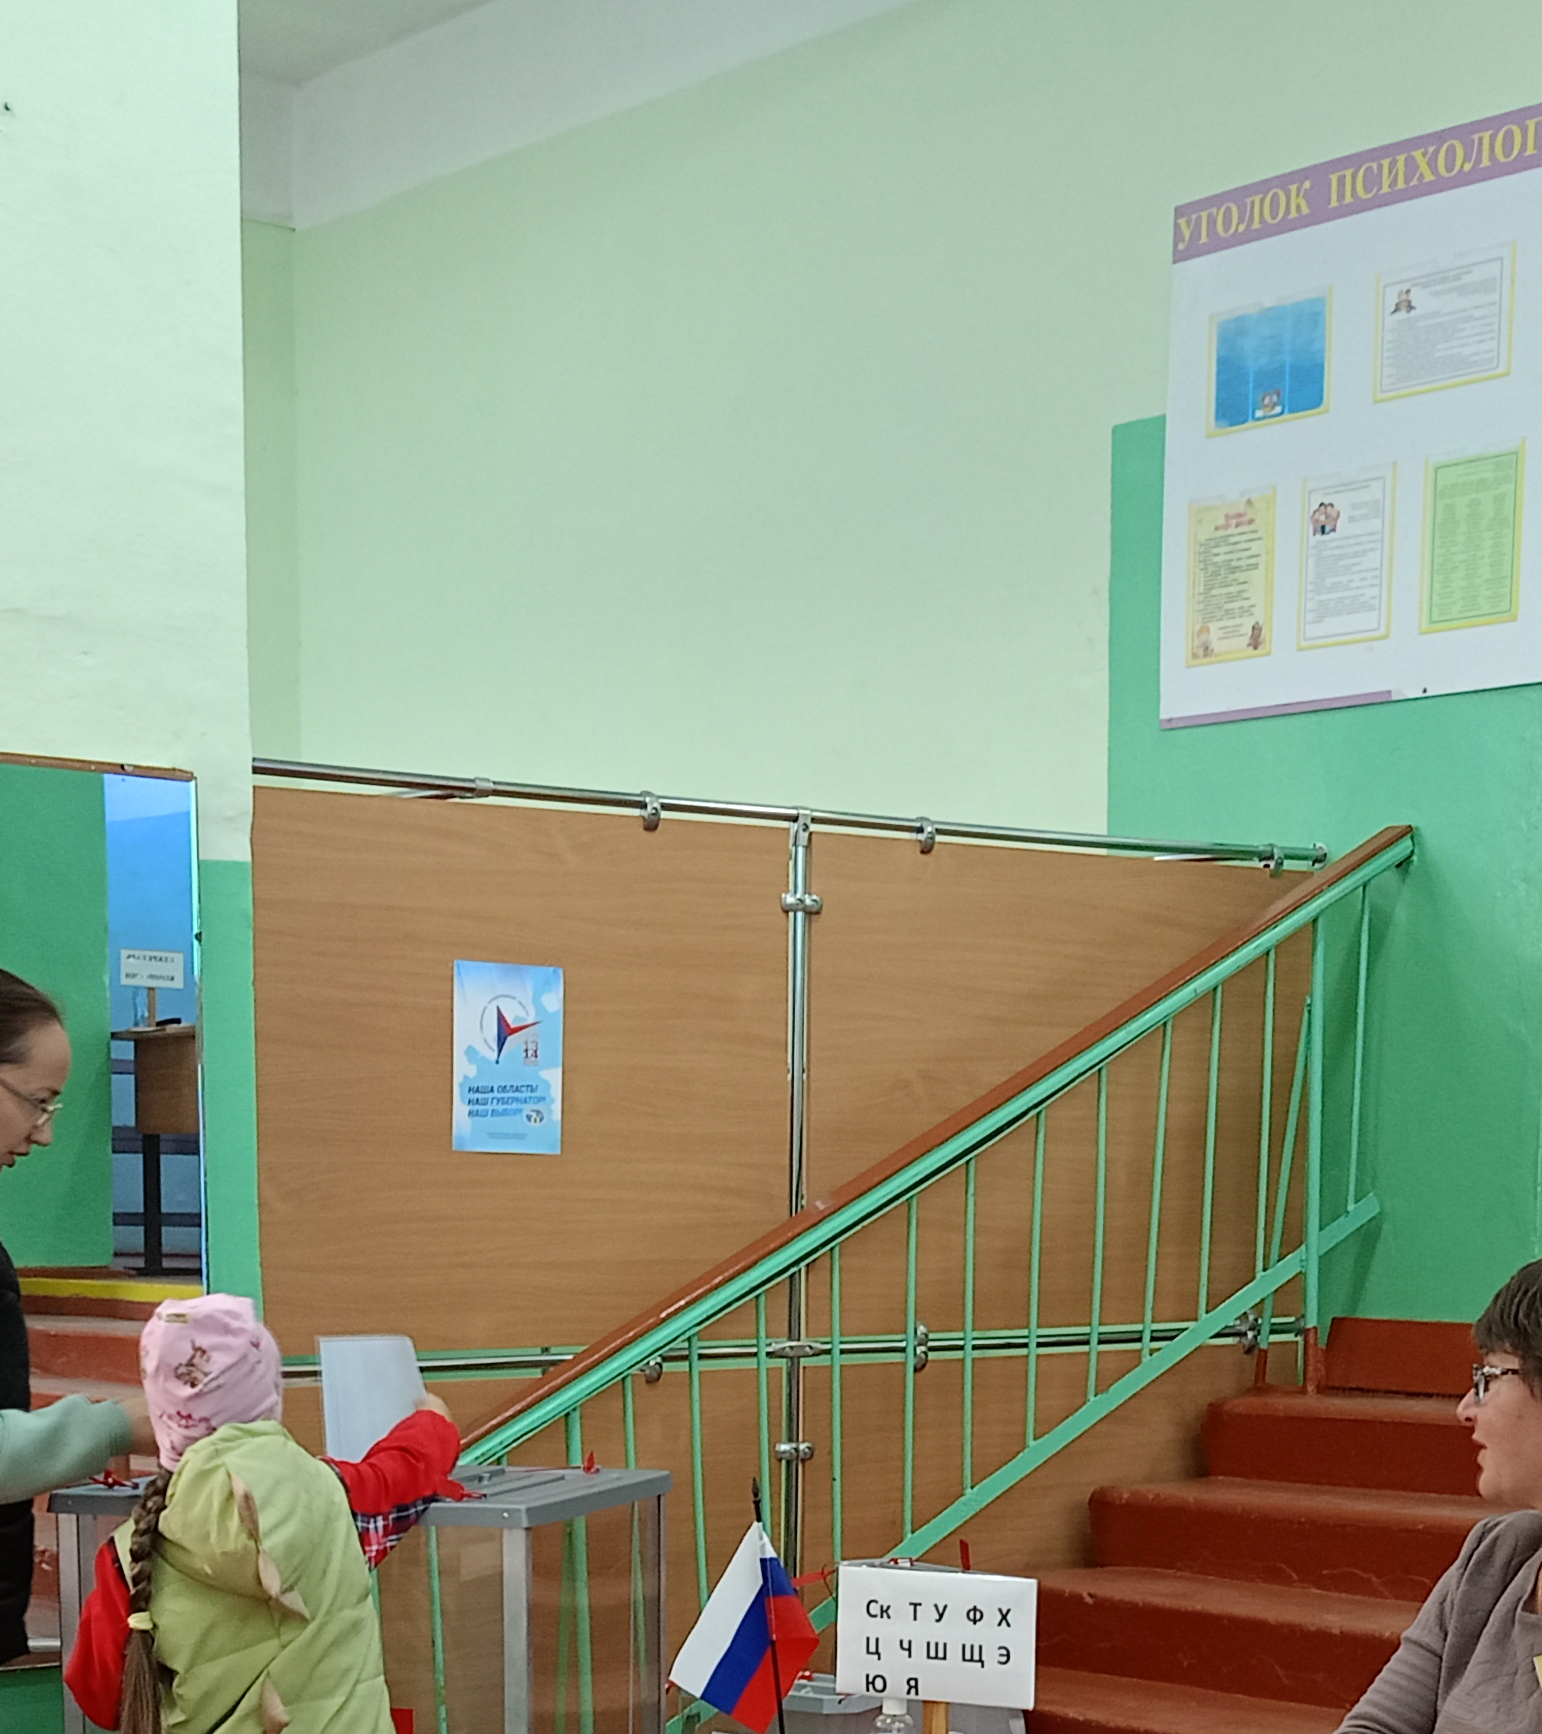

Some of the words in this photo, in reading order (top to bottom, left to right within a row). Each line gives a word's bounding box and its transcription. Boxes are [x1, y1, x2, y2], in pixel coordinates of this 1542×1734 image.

[1175, 180, 1312, 252] УГОЛОК
[468, 1085, 494, 1094] НАША
[468, 1097, 489, 1106] НАШ
[468, 1108, 489, 1117] НАШ
[866, 1599, 891, 1620] Ск
[909, 1602, 922, 1621] Т
[934, 1603, 948, 1623] У
[966, 1605, 984, 1625] Ф
[997, 1607, 1012, 1628] Х
[865, 1636, 881, 1661] Ц
[899, 1639, 912, 1659] Ч
[926, 1641, 947, 1661] Ш
[961, 1643, 985, 1669] Щ
[997, 1646, 1011, 1665] Э
[865, 1673, 887, 1694] Ю
[906, 1677, 919, 1696] Я
